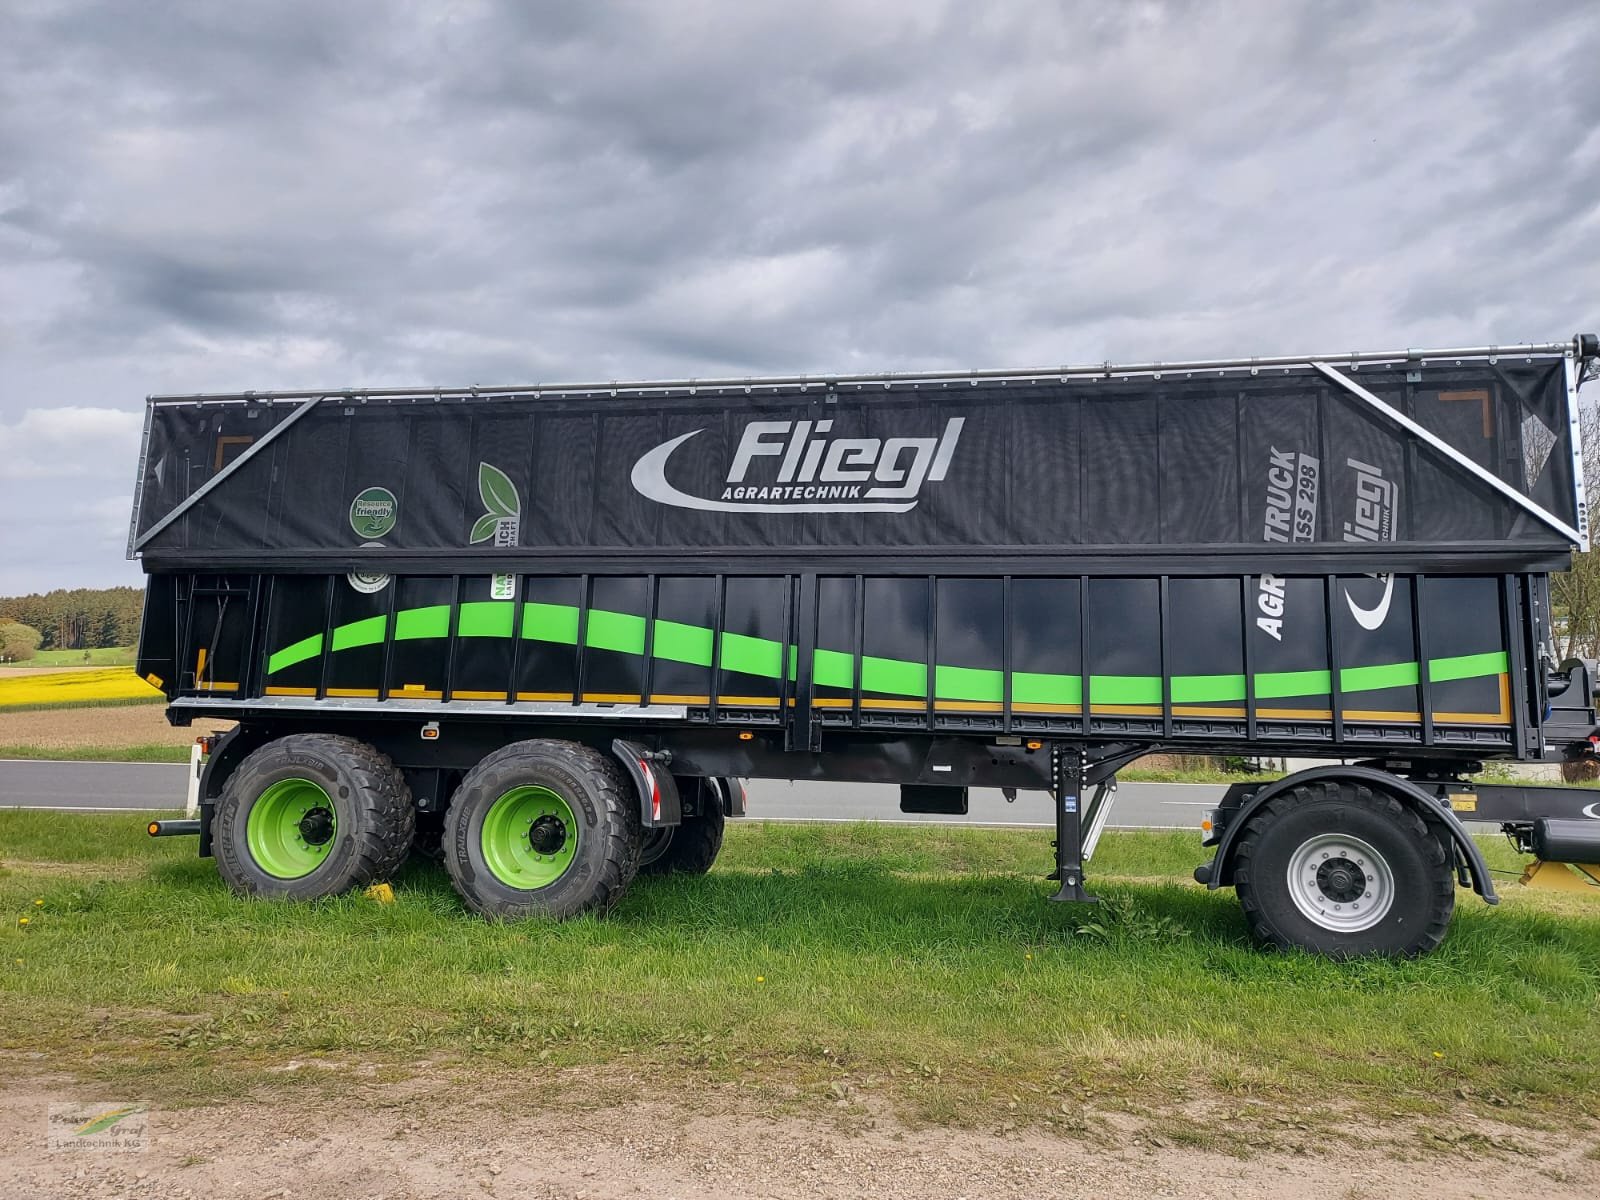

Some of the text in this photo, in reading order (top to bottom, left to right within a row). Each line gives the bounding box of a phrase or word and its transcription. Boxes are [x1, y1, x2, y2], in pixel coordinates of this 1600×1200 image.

[726, 417, 966, 499] Fliegl
[721, 485, 862, 500] AGRARTECHNIK
[1263, 446, 1296, 543] TRUCK
[1299, 464, 1317, 504] 298
[356, 506, 392, 518] friendly
[357, 500, 392, 508] Resource
